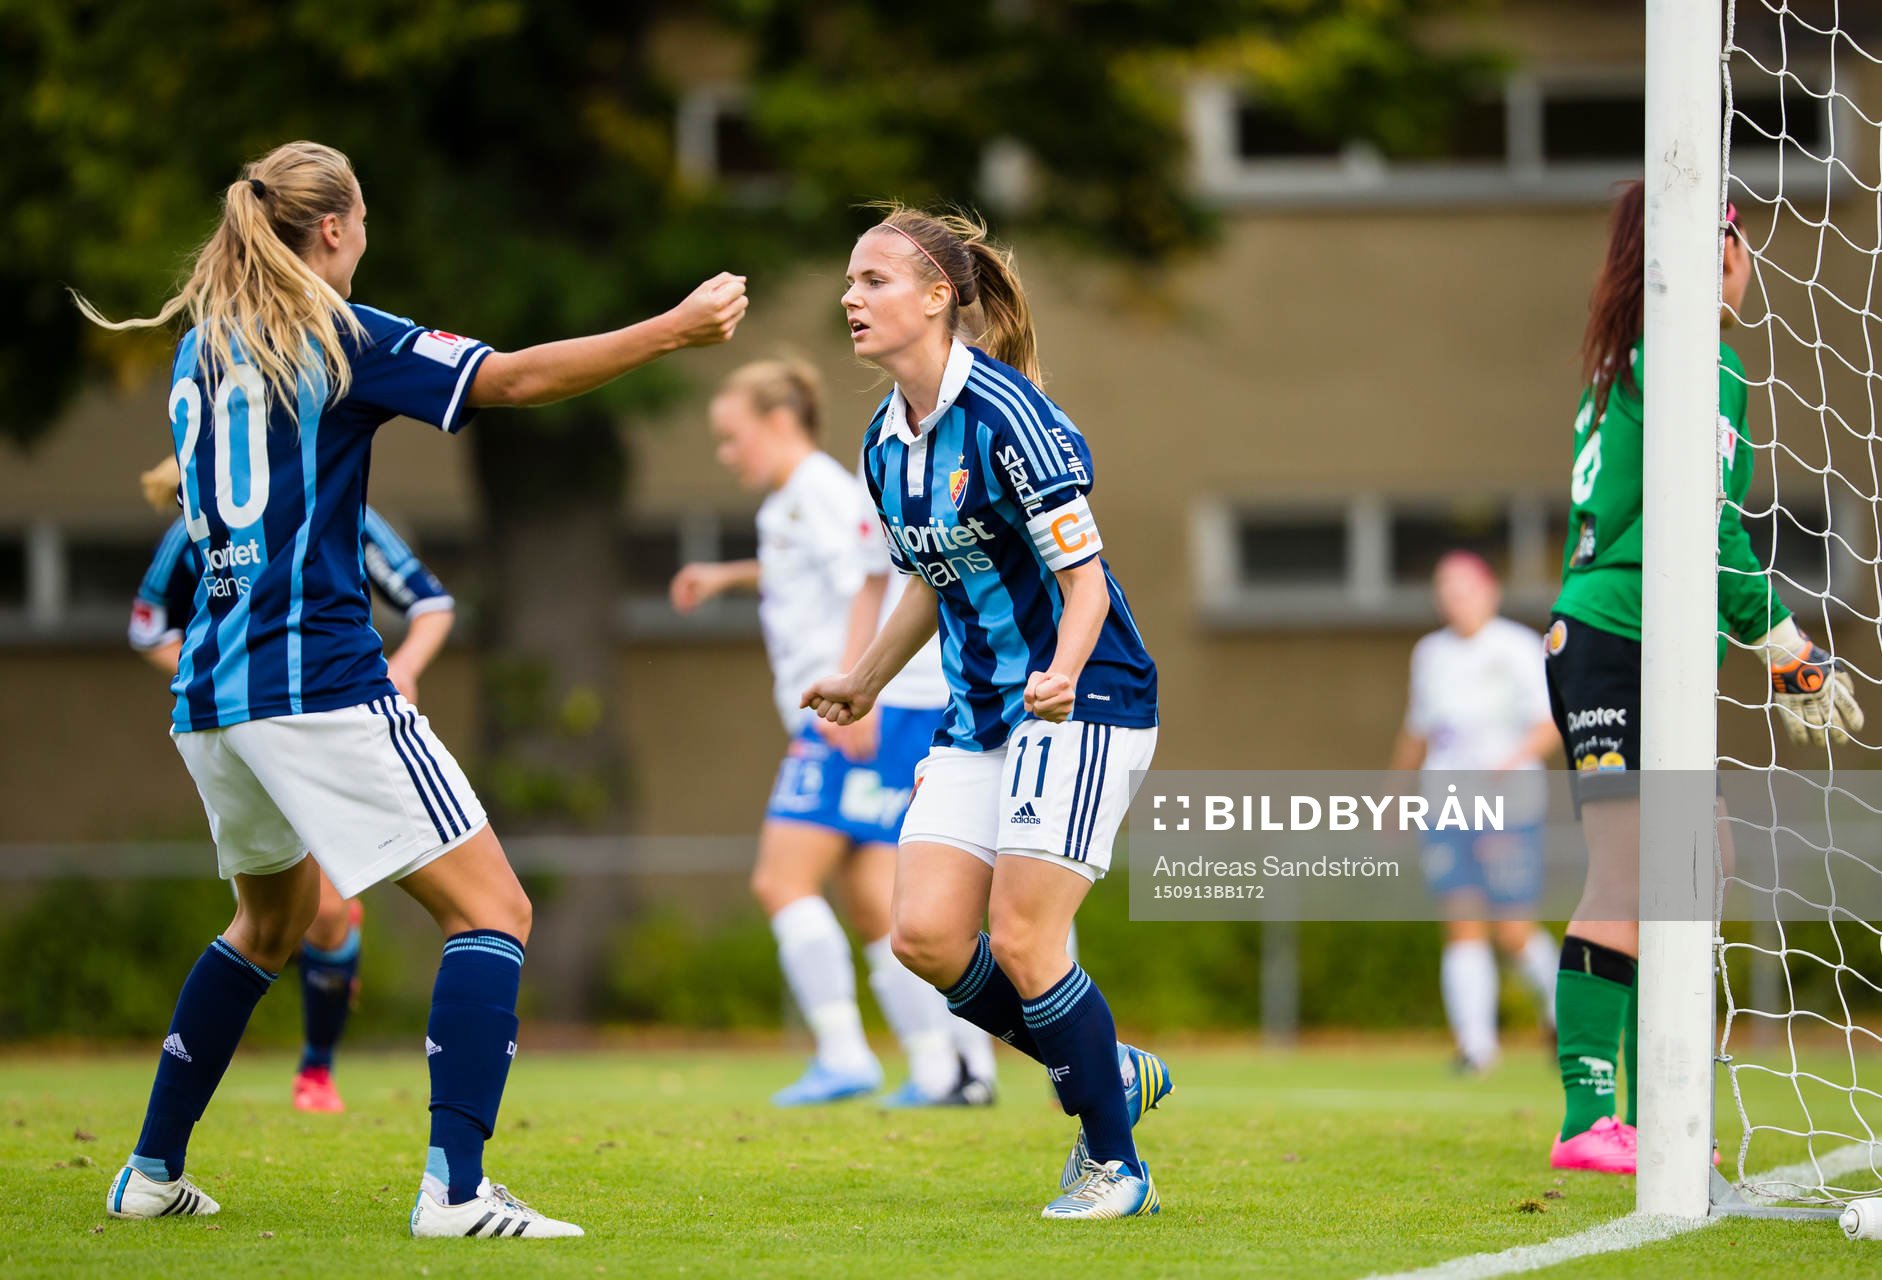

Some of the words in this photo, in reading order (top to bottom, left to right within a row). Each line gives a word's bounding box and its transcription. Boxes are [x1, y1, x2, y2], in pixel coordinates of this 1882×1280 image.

[168, 364, 270, 543] 20
[995, 445, 1046, 519] stadiu
[890, 516, 996, 553] rioritet
[914, 551, 994, 587] nans
[1010, 735, 1053, 798] 11
[1010, 815, 1041, 825] adidas
